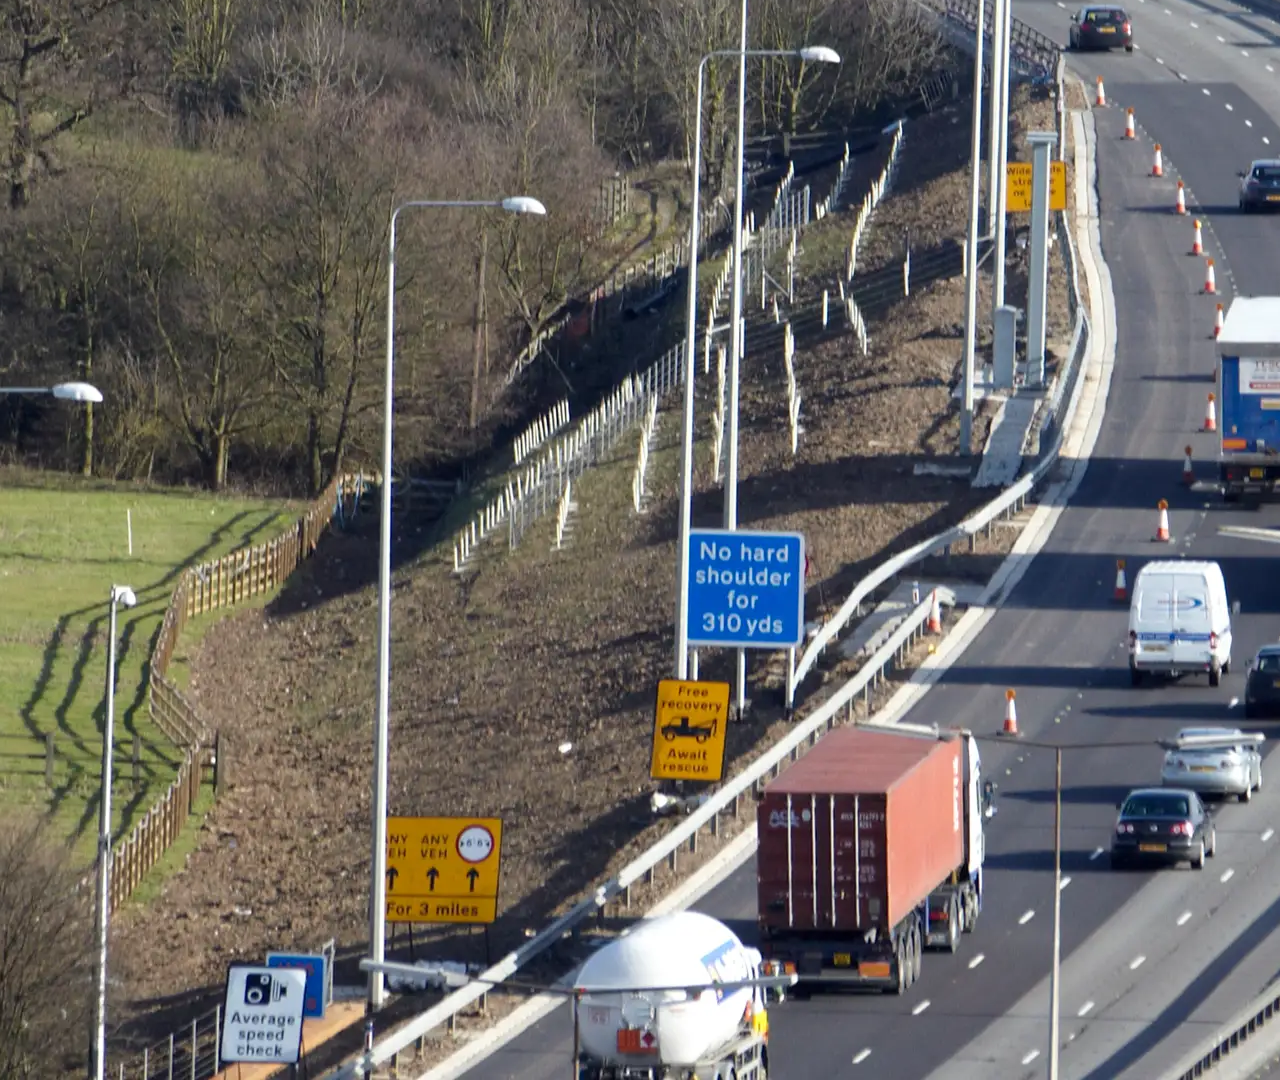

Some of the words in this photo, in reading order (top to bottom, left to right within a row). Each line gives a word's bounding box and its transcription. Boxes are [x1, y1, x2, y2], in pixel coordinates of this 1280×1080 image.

[700, 543, 731, 561] No
[740, 542, 789, 562] hard
[696, 566, 790, 585] shoulder
[727, 589, 758, 609] for
[703, 613, 741, 632] 310
[746, 614, 783, 636] yds
[678, 685, 709, 697] Free
[661, 700, 723, 712] recovery
[667, 748, 708, 761] Await
[663, 762, 709, 774] rescue
[421, 834, 450, 845] ANY
[386, 848, 407, 859] EH
[420, 848, 448, 859] VEH
[387, 901, 412, 916] For
[419, 901, 429, 916] 3
[436, 901, 479, 917] miles
[230, 1012, 296, 1027] Average
[238, 1028, 285, 1043] speed
[237, 1042, 283, 1057] check
